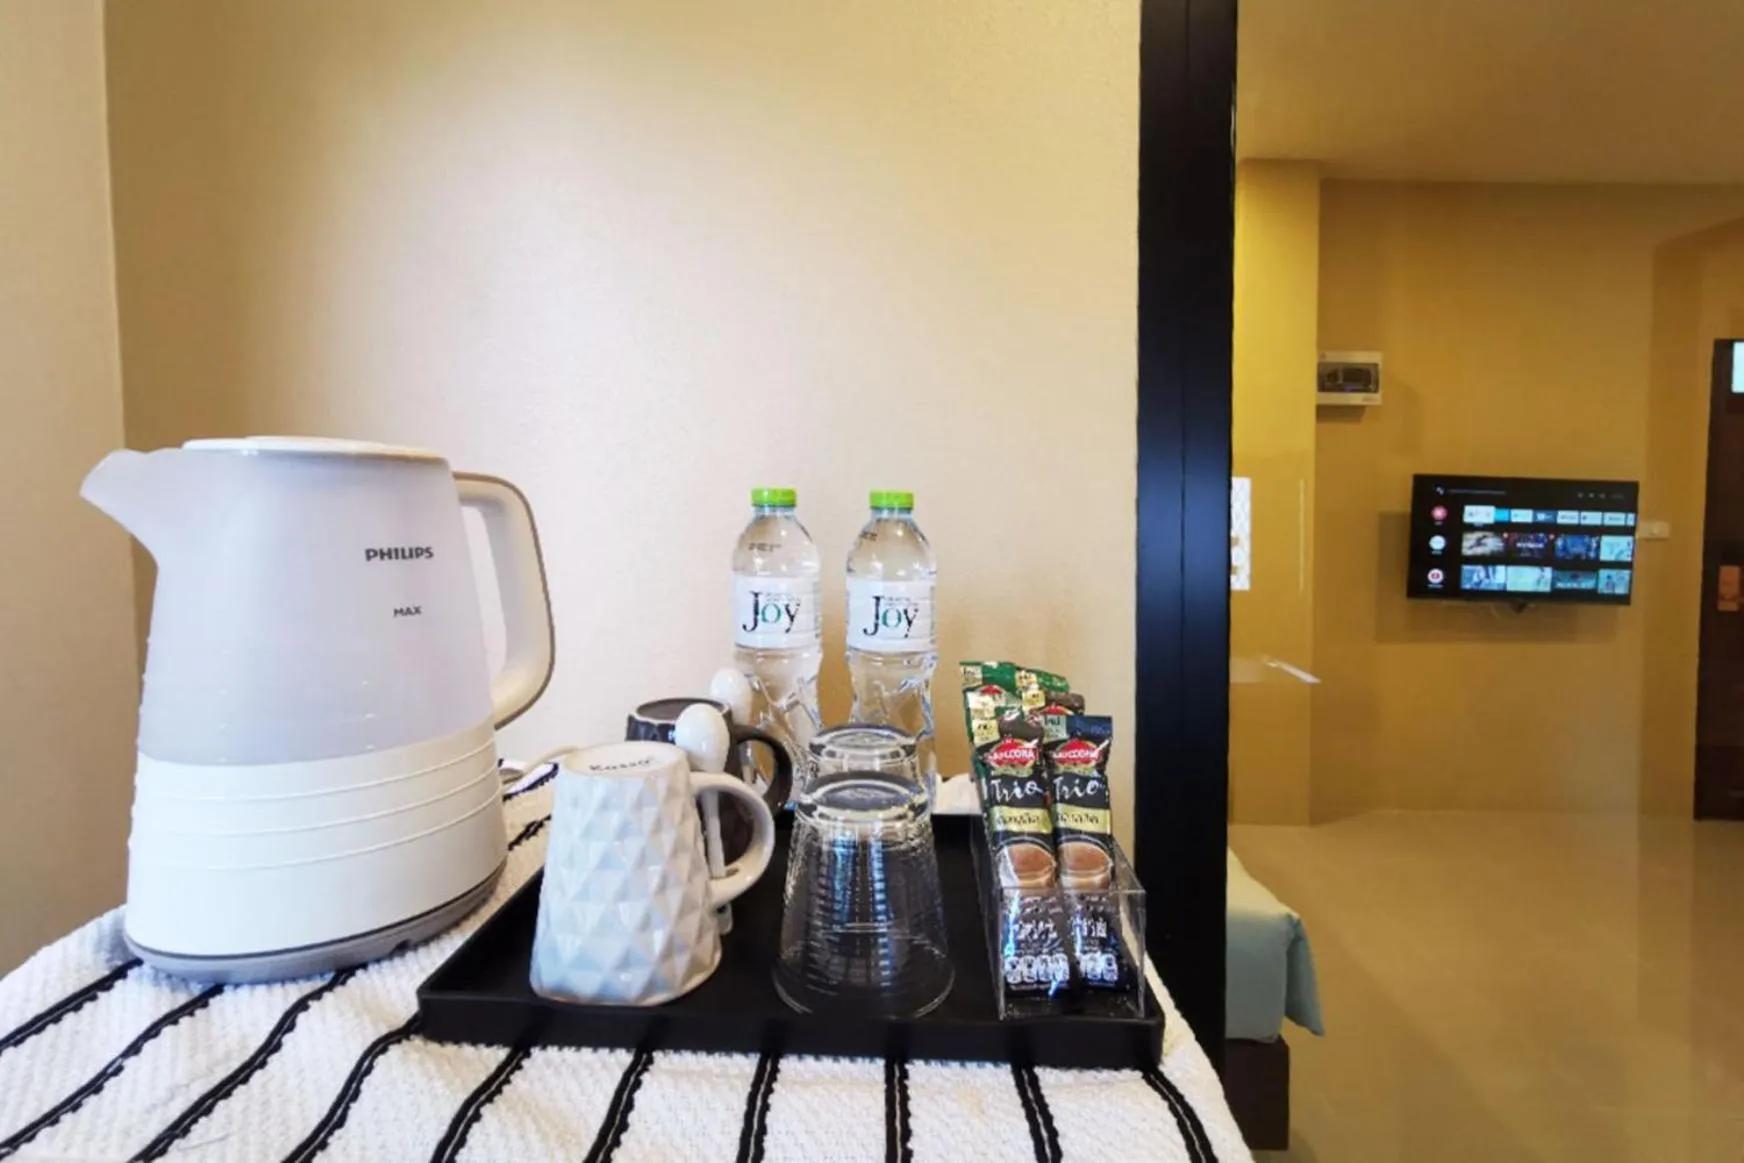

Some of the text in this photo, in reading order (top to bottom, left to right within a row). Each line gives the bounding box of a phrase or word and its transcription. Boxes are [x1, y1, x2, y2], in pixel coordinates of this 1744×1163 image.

[365, 546, 434, 561] PHILIPS
[393, 605, 422, 617] MAX
[742, 591, 801, 633] Joy
[863, 595, 919, 638] Joy
[991, 779, 1044, 802] Trio
[1053, 776, 1100, 801] Trio
